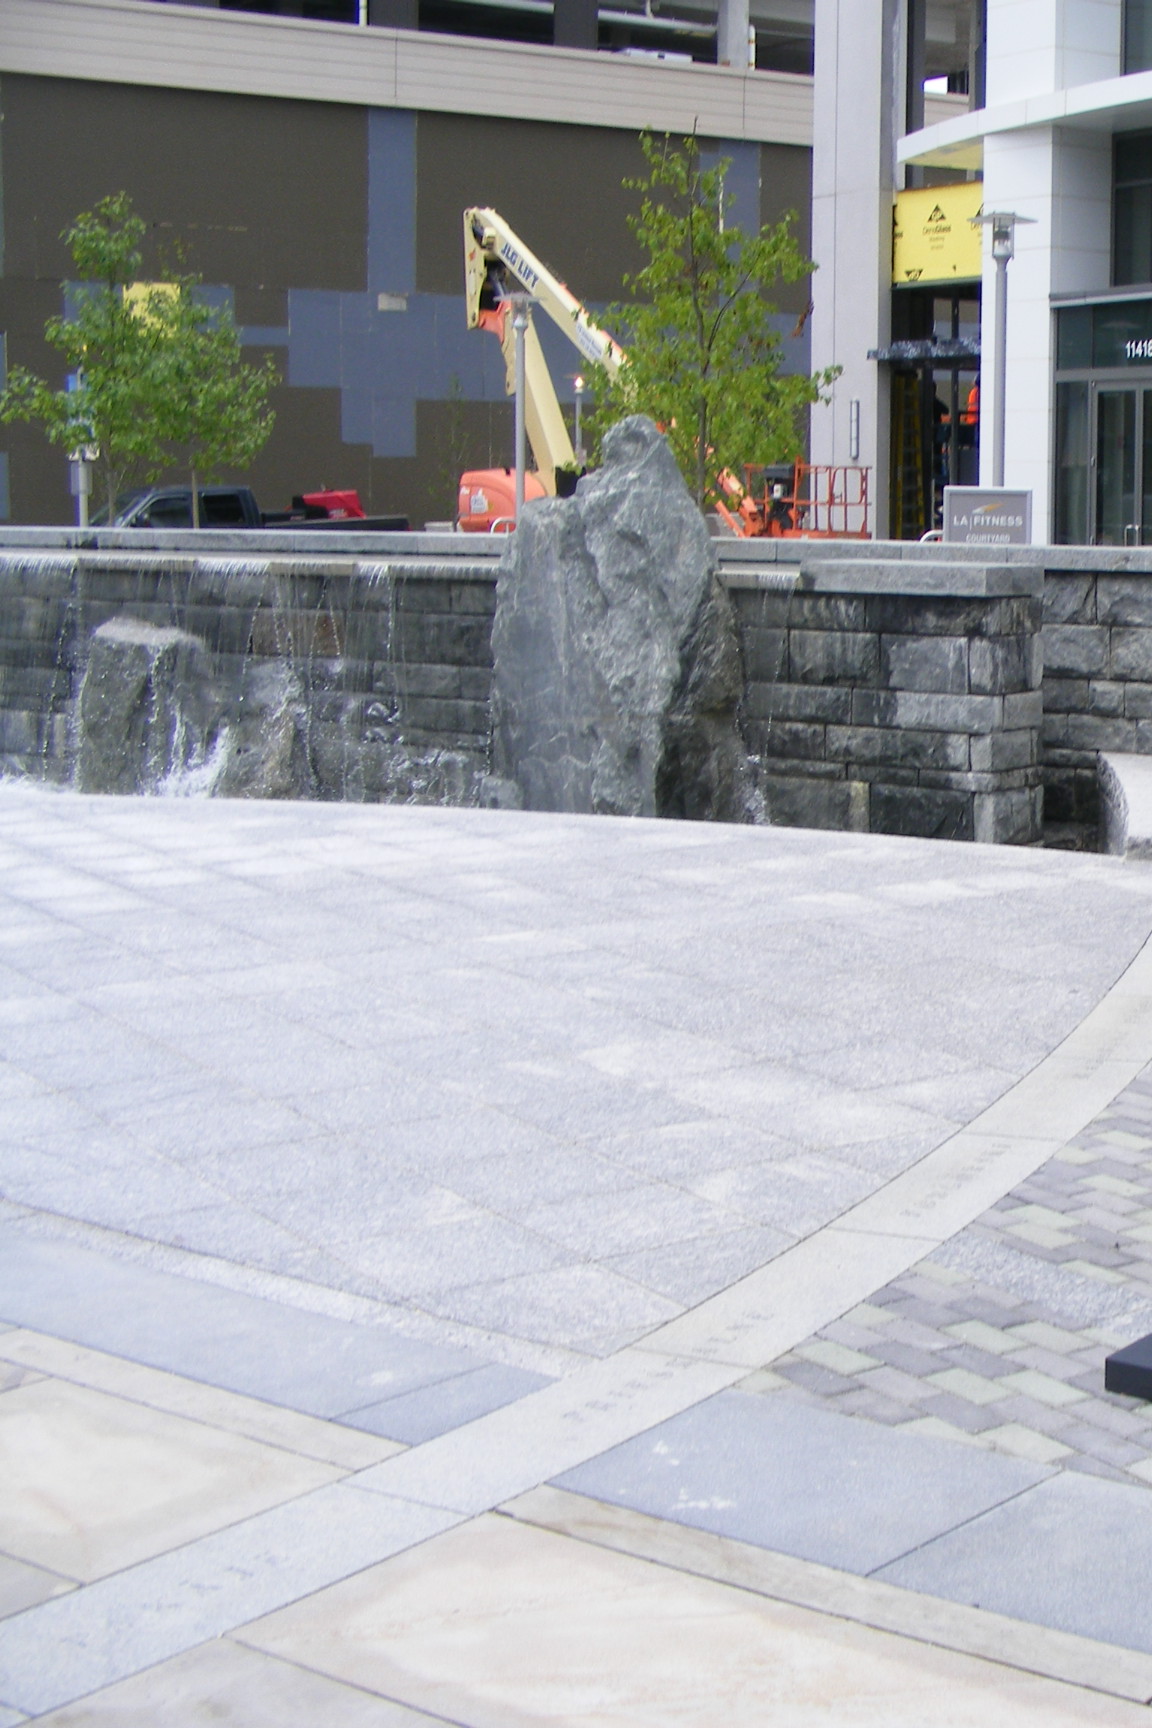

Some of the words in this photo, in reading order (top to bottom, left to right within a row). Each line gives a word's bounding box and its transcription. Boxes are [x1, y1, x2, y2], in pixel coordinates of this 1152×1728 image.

[501, 242, 520, 266] JLG
[518, 259, 540, 288] LIFT
[973, 515, 1023, 527] FITNESS
